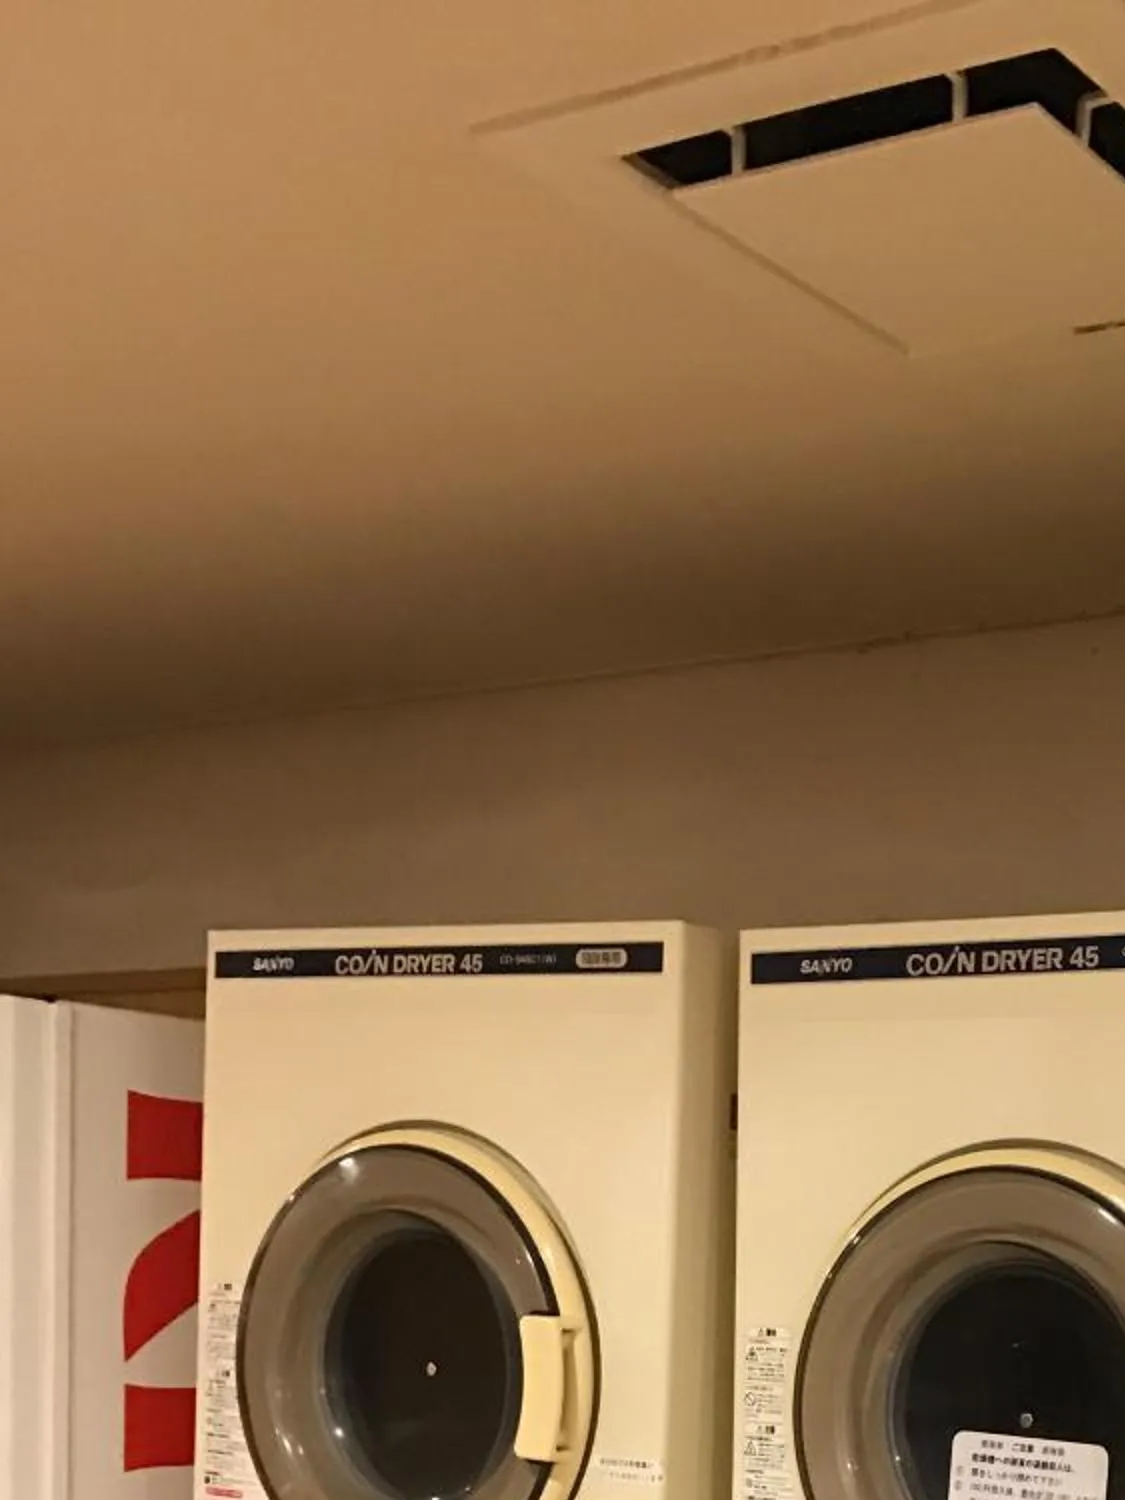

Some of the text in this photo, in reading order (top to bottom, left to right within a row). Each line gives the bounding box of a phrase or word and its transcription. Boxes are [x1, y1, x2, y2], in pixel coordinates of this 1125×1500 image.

[253, 956, 295, 971] SANYO
[394, 953, 455, 974] DRYER
[460, 953, 483, 973] 45
[800, 957, 853, 974] SANYO
[981, 949, 1064, 975] DRYER
[1069, 946, 1100, 970] 45
